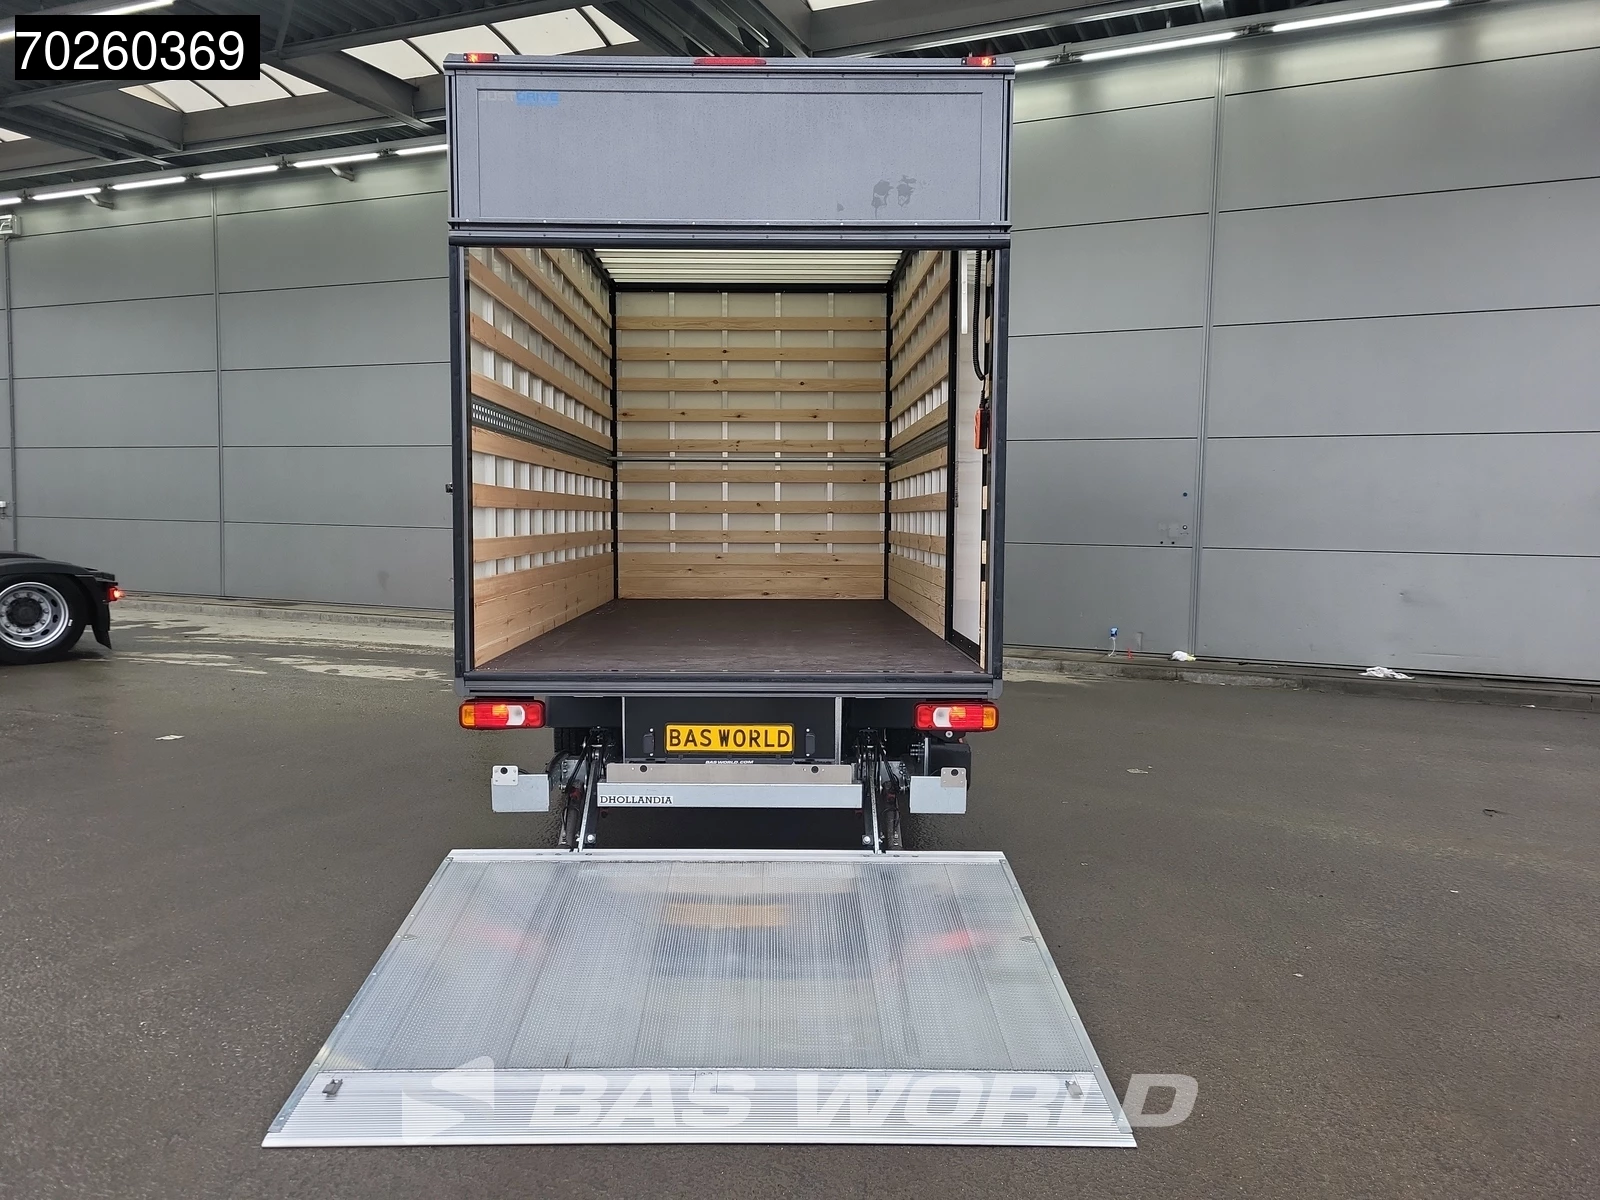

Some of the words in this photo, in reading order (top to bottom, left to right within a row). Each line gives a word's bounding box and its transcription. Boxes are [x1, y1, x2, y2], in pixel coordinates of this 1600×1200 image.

[669, 729, 712, 747] BAS
[719, 729, 790, 748] WORLD
[600, 796, 672, 804] DHOLLANDIA
